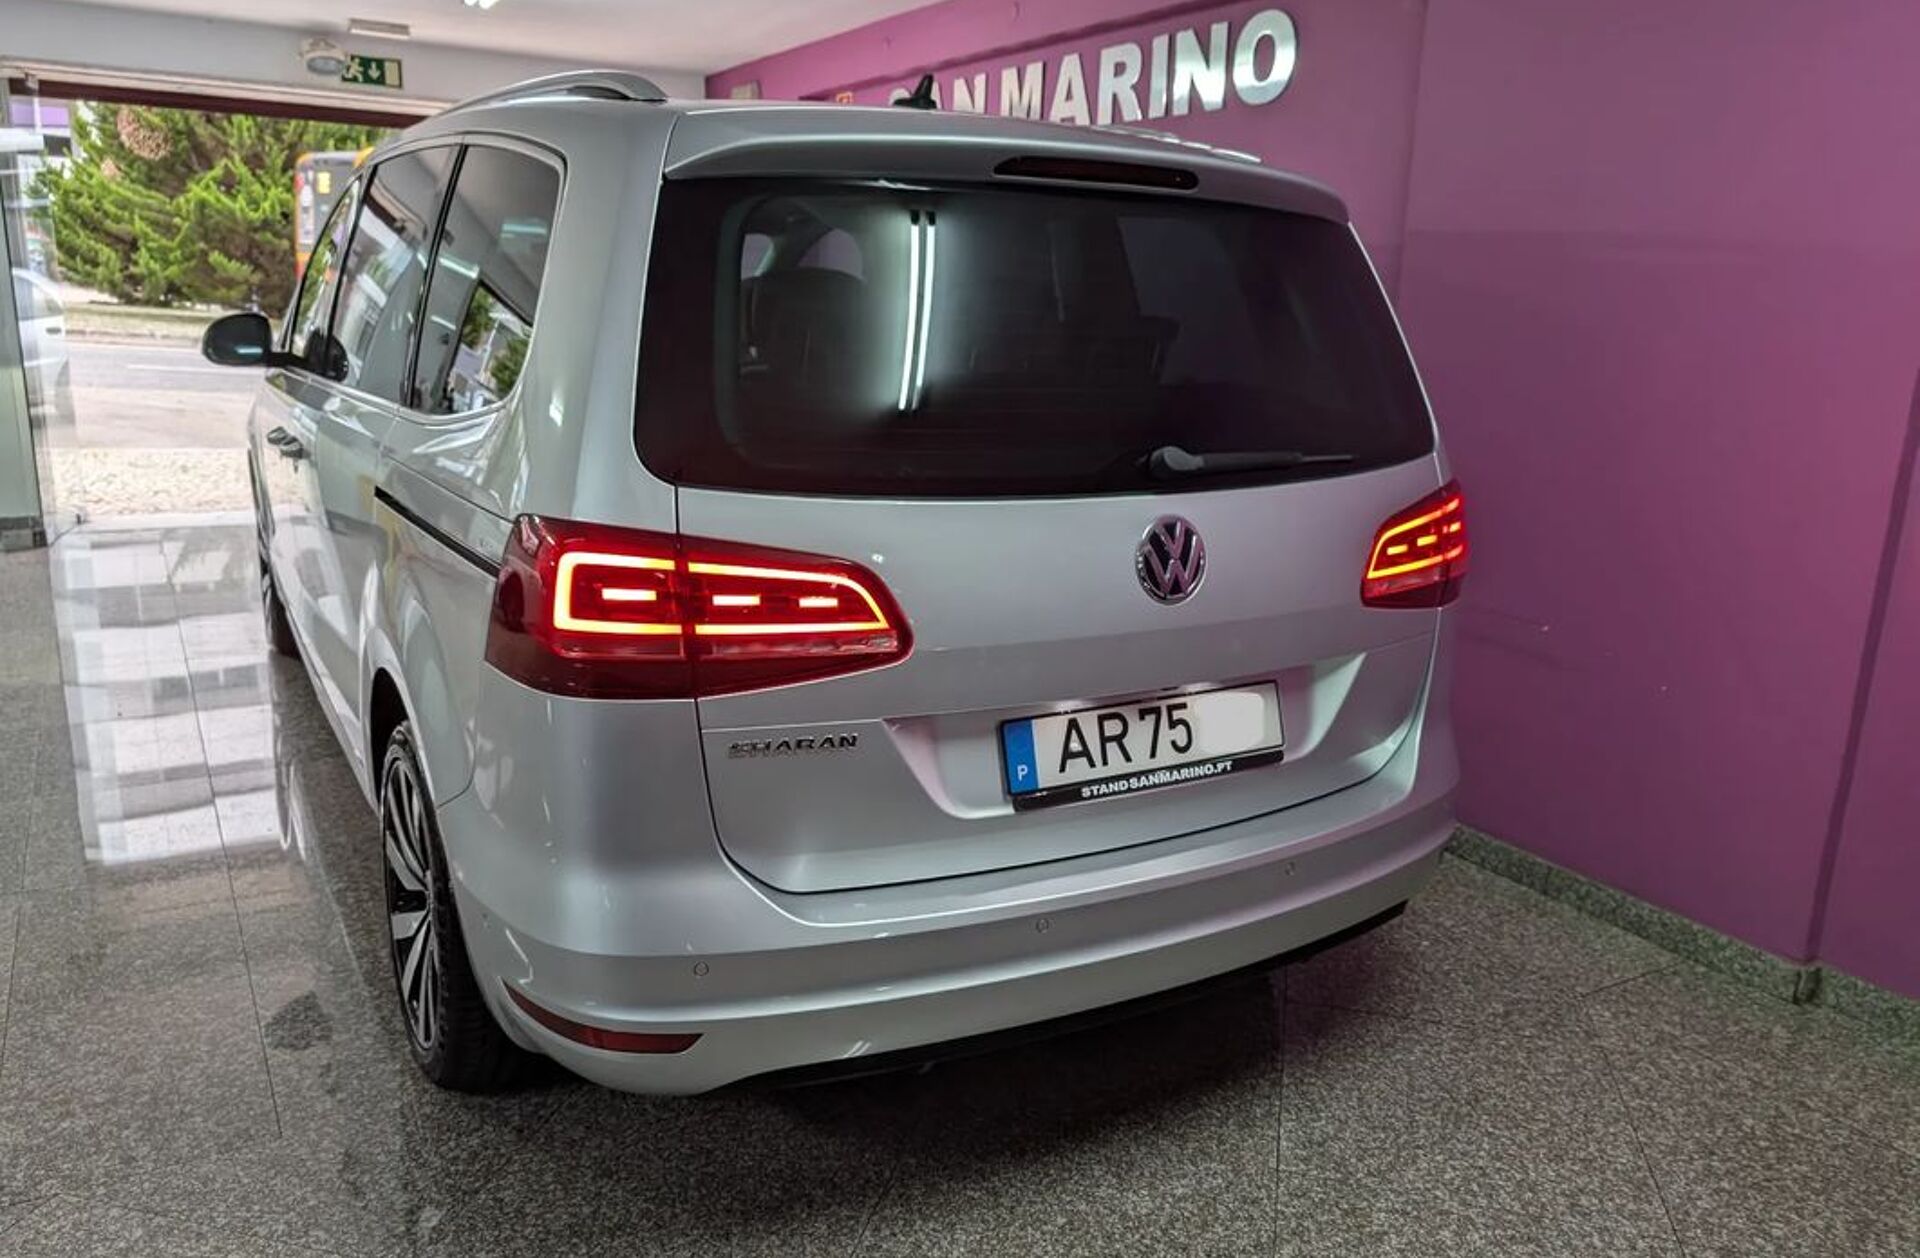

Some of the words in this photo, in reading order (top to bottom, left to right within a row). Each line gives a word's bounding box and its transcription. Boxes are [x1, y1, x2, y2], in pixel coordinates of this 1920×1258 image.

[1000, 9, 1297, 127] MARINO
[728, 733, 859, 754] SHARAN
[1016, 764, 1028, 782] P
